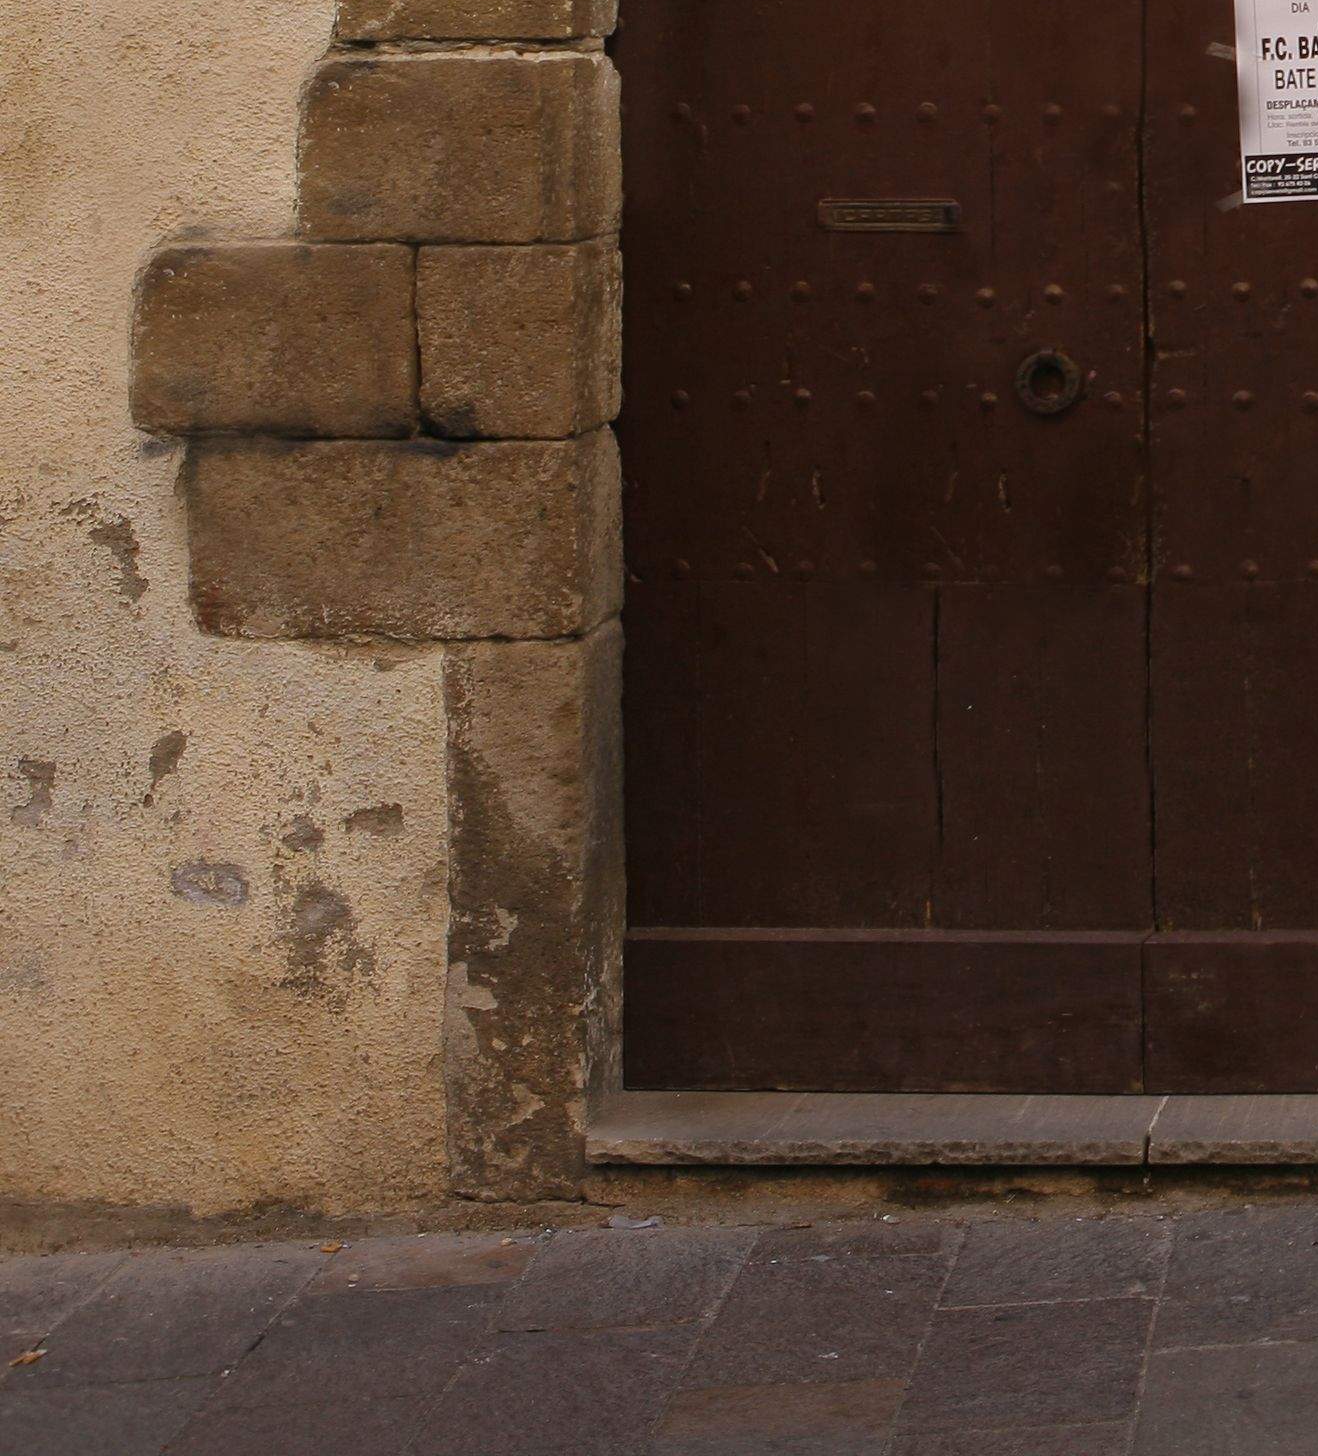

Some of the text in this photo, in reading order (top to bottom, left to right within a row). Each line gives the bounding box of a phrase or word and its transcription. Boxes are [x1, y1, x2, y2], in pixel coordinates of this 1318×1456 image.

[1291, 1, 1310, 13] DIA
[1261, 36, 1293, 61] F.C.
[1275, 68, 1316, 90] BATE
